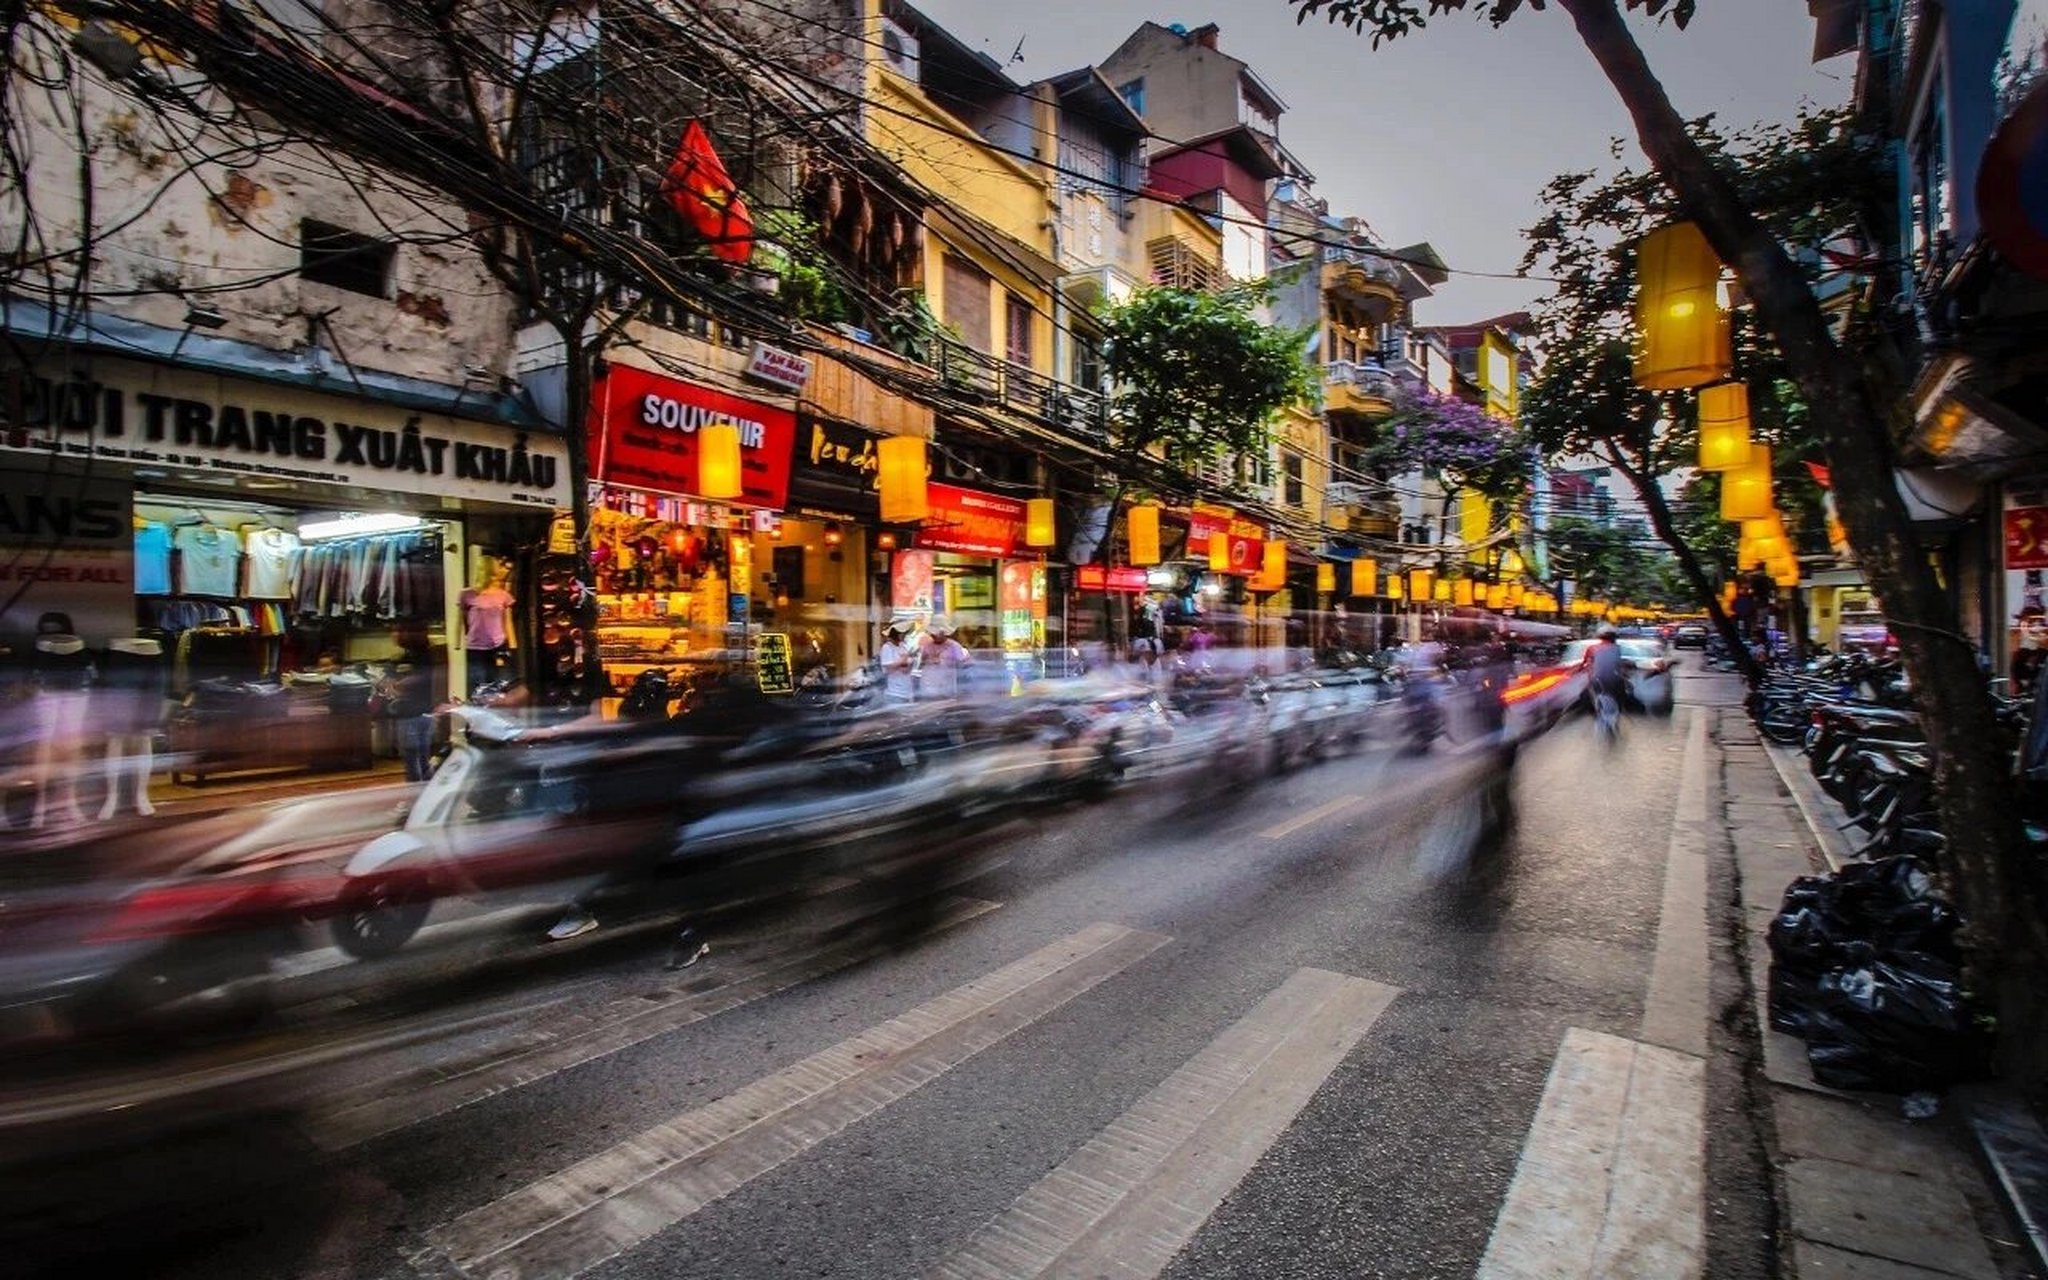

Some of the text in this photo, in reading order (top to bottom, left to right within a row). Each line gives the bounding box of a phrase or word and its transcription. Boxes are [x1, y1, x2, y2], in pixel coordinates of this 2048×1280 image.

[137, 393, 327, 460] TRANG
[333, 416, 450, 476] XUẤT
[454, 431, 557, 490] KHẨU
[20, 565, 75, 583] FOR
[78, 566, 126, 584] ALL
